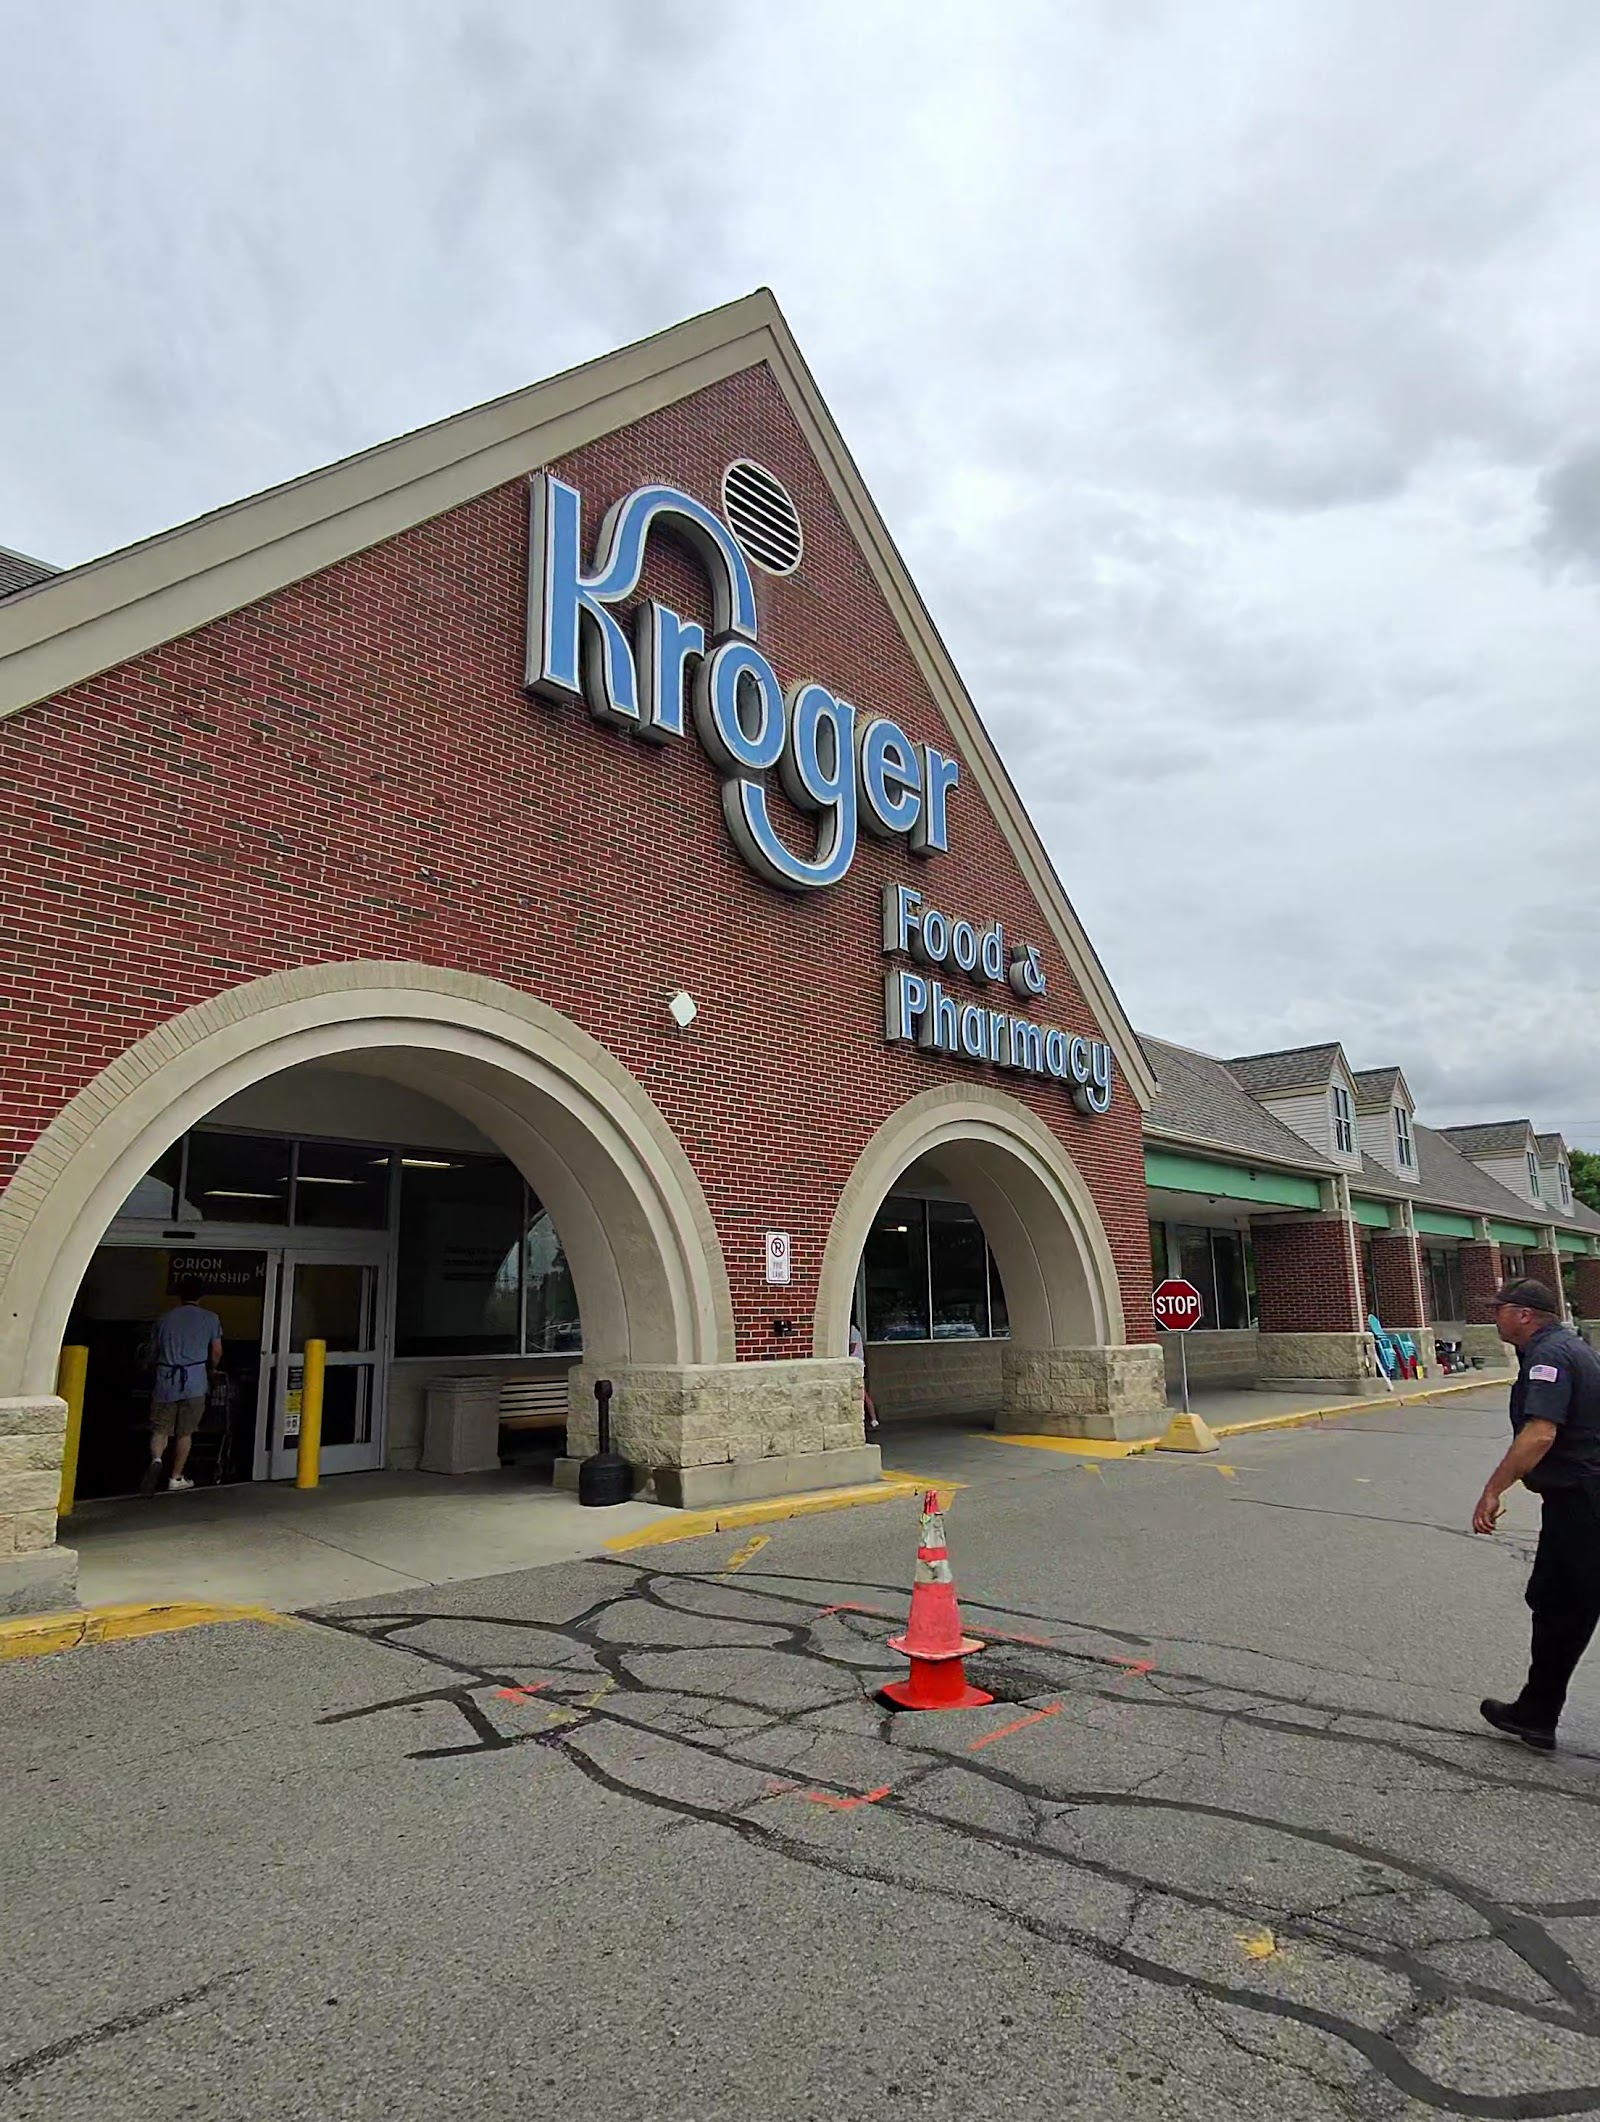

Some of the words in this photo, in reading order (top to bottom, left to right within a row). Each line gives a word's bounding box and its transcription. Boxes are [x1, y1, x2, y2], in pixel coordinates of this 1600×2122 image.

[542, 474, 959, 887] Kroger
[896, 885, 1005, 983] Food
[1016, 943, 1048, 997] &
[897, 970, 1112, 1114] Pharmacy
[173, 1257, 222, 1270] ORION
[1156, 1295, 1198, 1315] STOP
